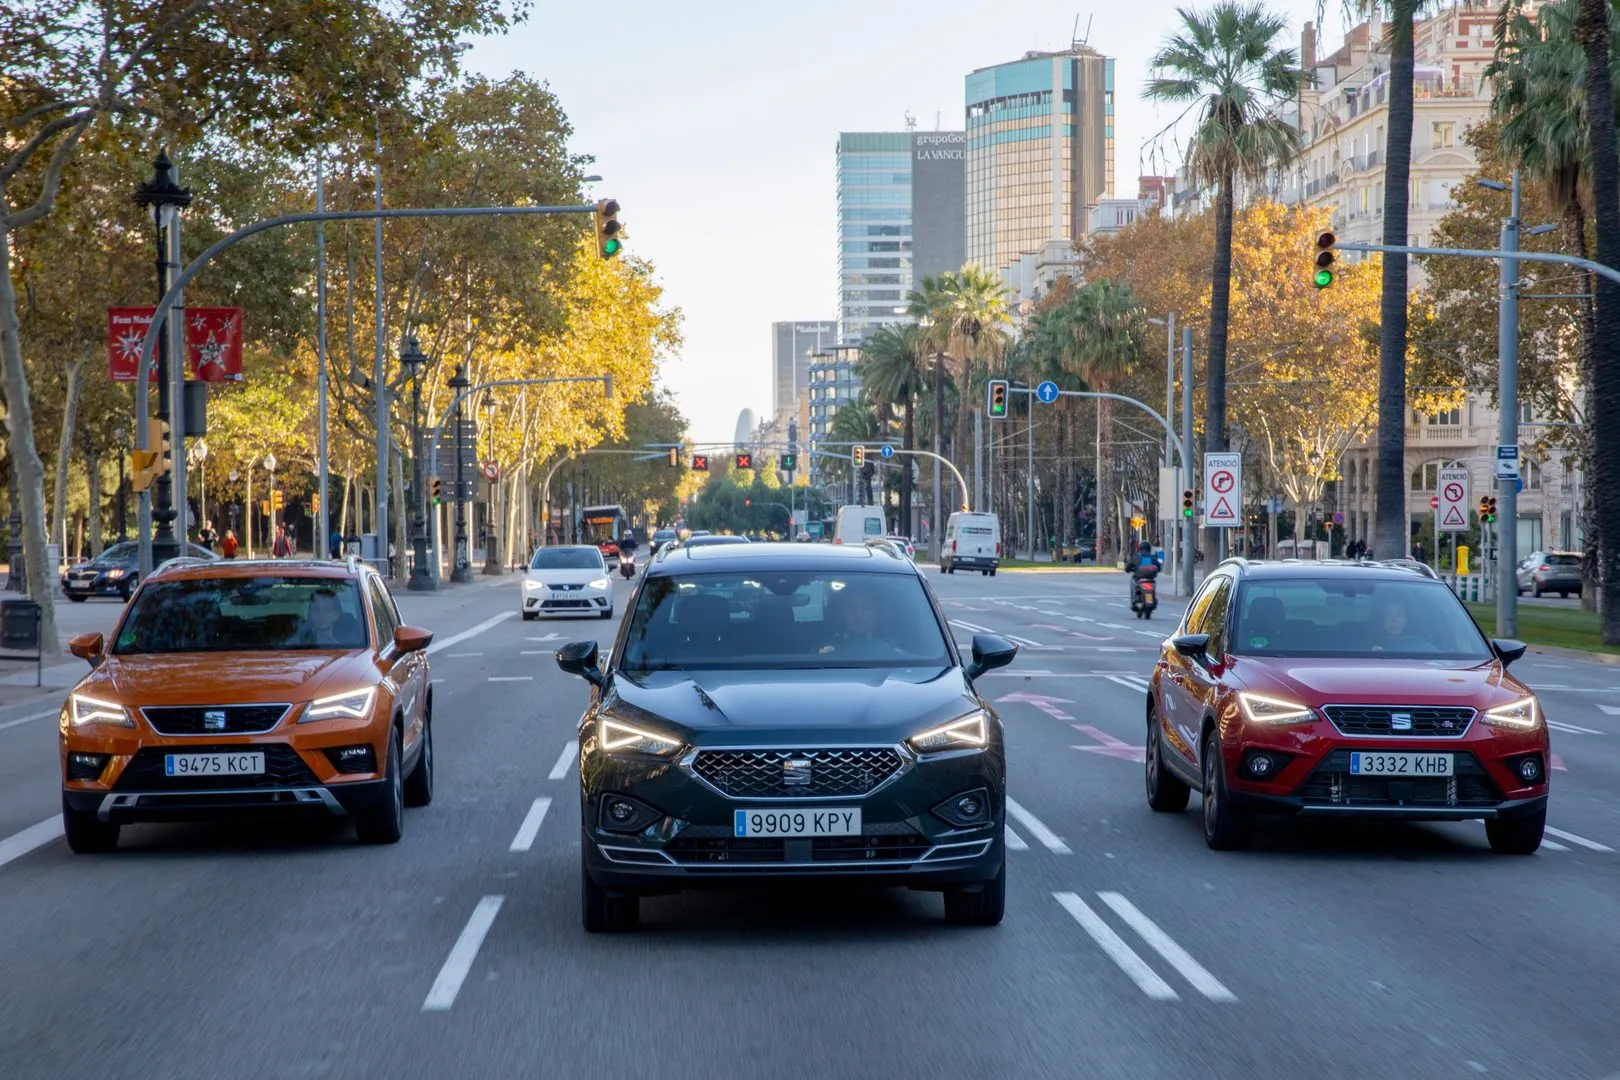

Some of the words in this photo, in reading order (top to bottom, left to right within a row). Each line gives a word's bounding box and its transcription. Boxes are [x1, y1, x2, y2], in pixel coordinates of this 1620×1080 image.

[917, 150, 930, 160] LA
[112, 315, 132, 324] Fem
[1208, 458, 1238, 468] ATENCIÓ
[179, 756, 221, 773] 9475
[227, 755, 259, 772] KCT
[1364, 756, 1408, 773] 3332
[1415, 756, 1447, 773] KHB
[751, 814, 805, 833] 9909
[814, 812, 853, 833] KPY
